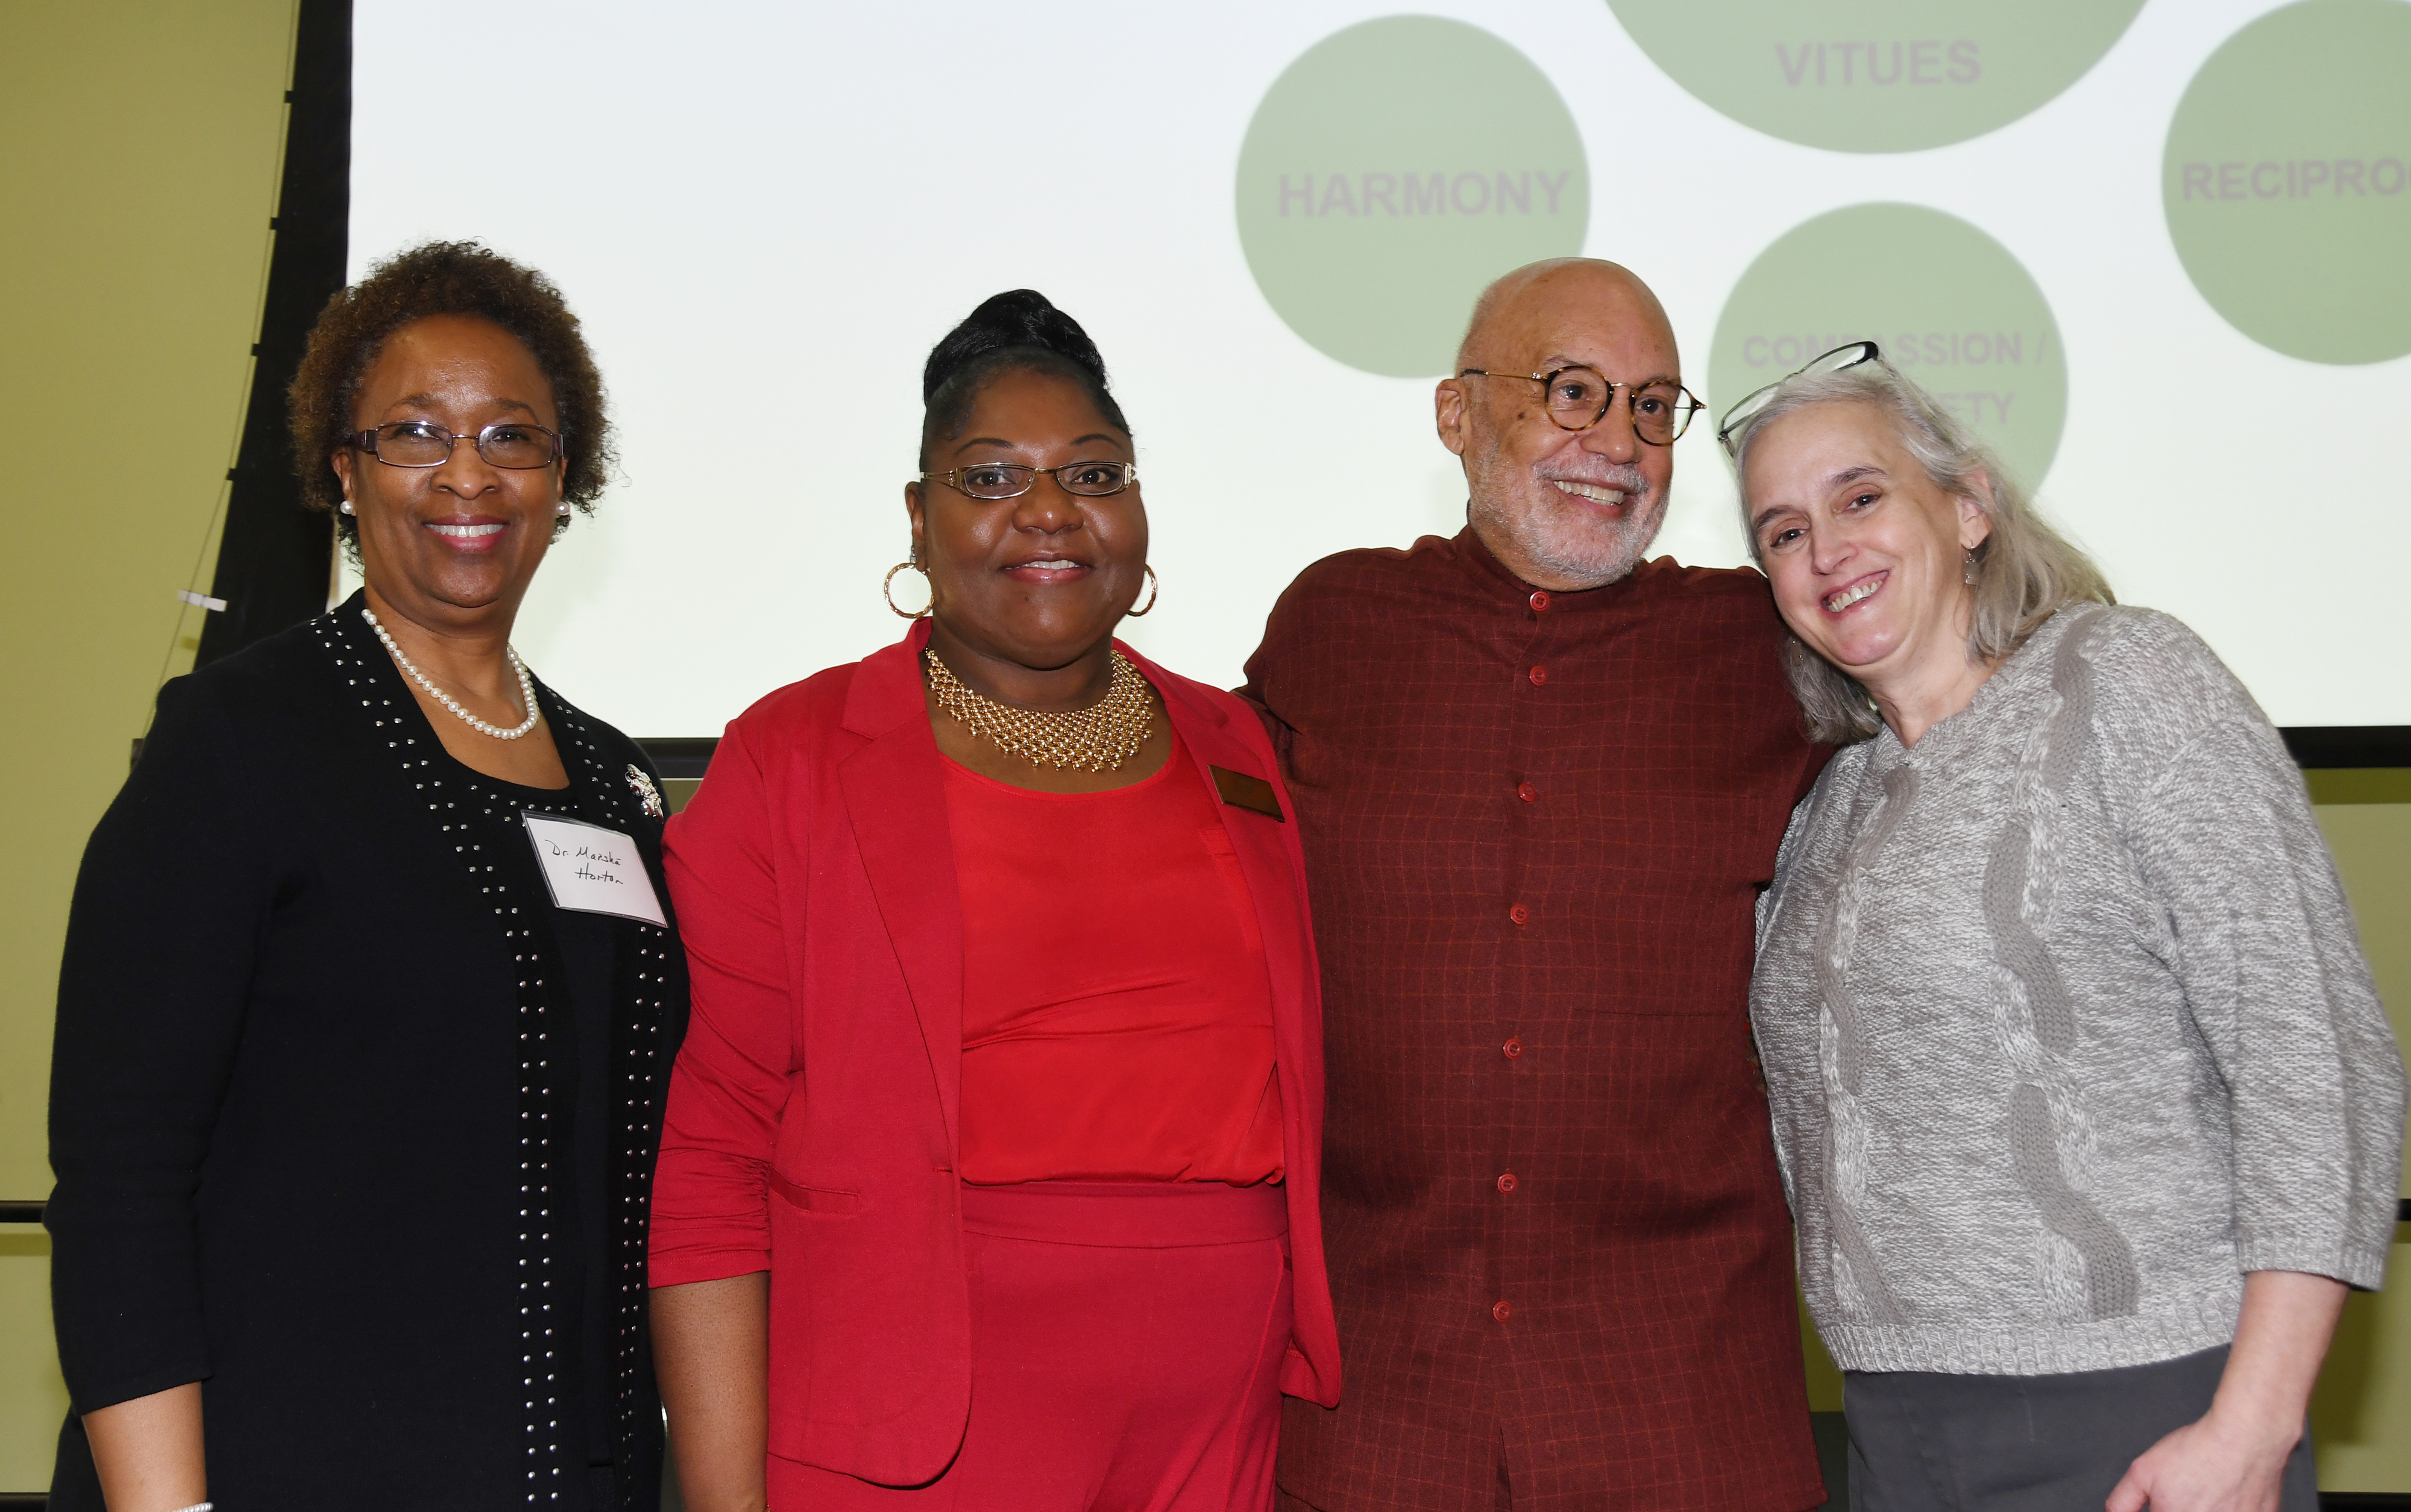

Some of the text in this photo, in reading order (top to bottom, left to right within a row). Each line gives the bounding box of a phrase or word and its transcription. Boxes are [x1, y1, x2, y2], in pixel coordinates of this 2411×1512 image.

[1773, 39, 1982, 87] VITUES
[1278, 171, 1571, 218] HARMONY
[2182, 157, 2411, 201] RECIPRO
[544, 839, 621, 866] Dr. Marsha
[574, 862, 623, 885] Horton
